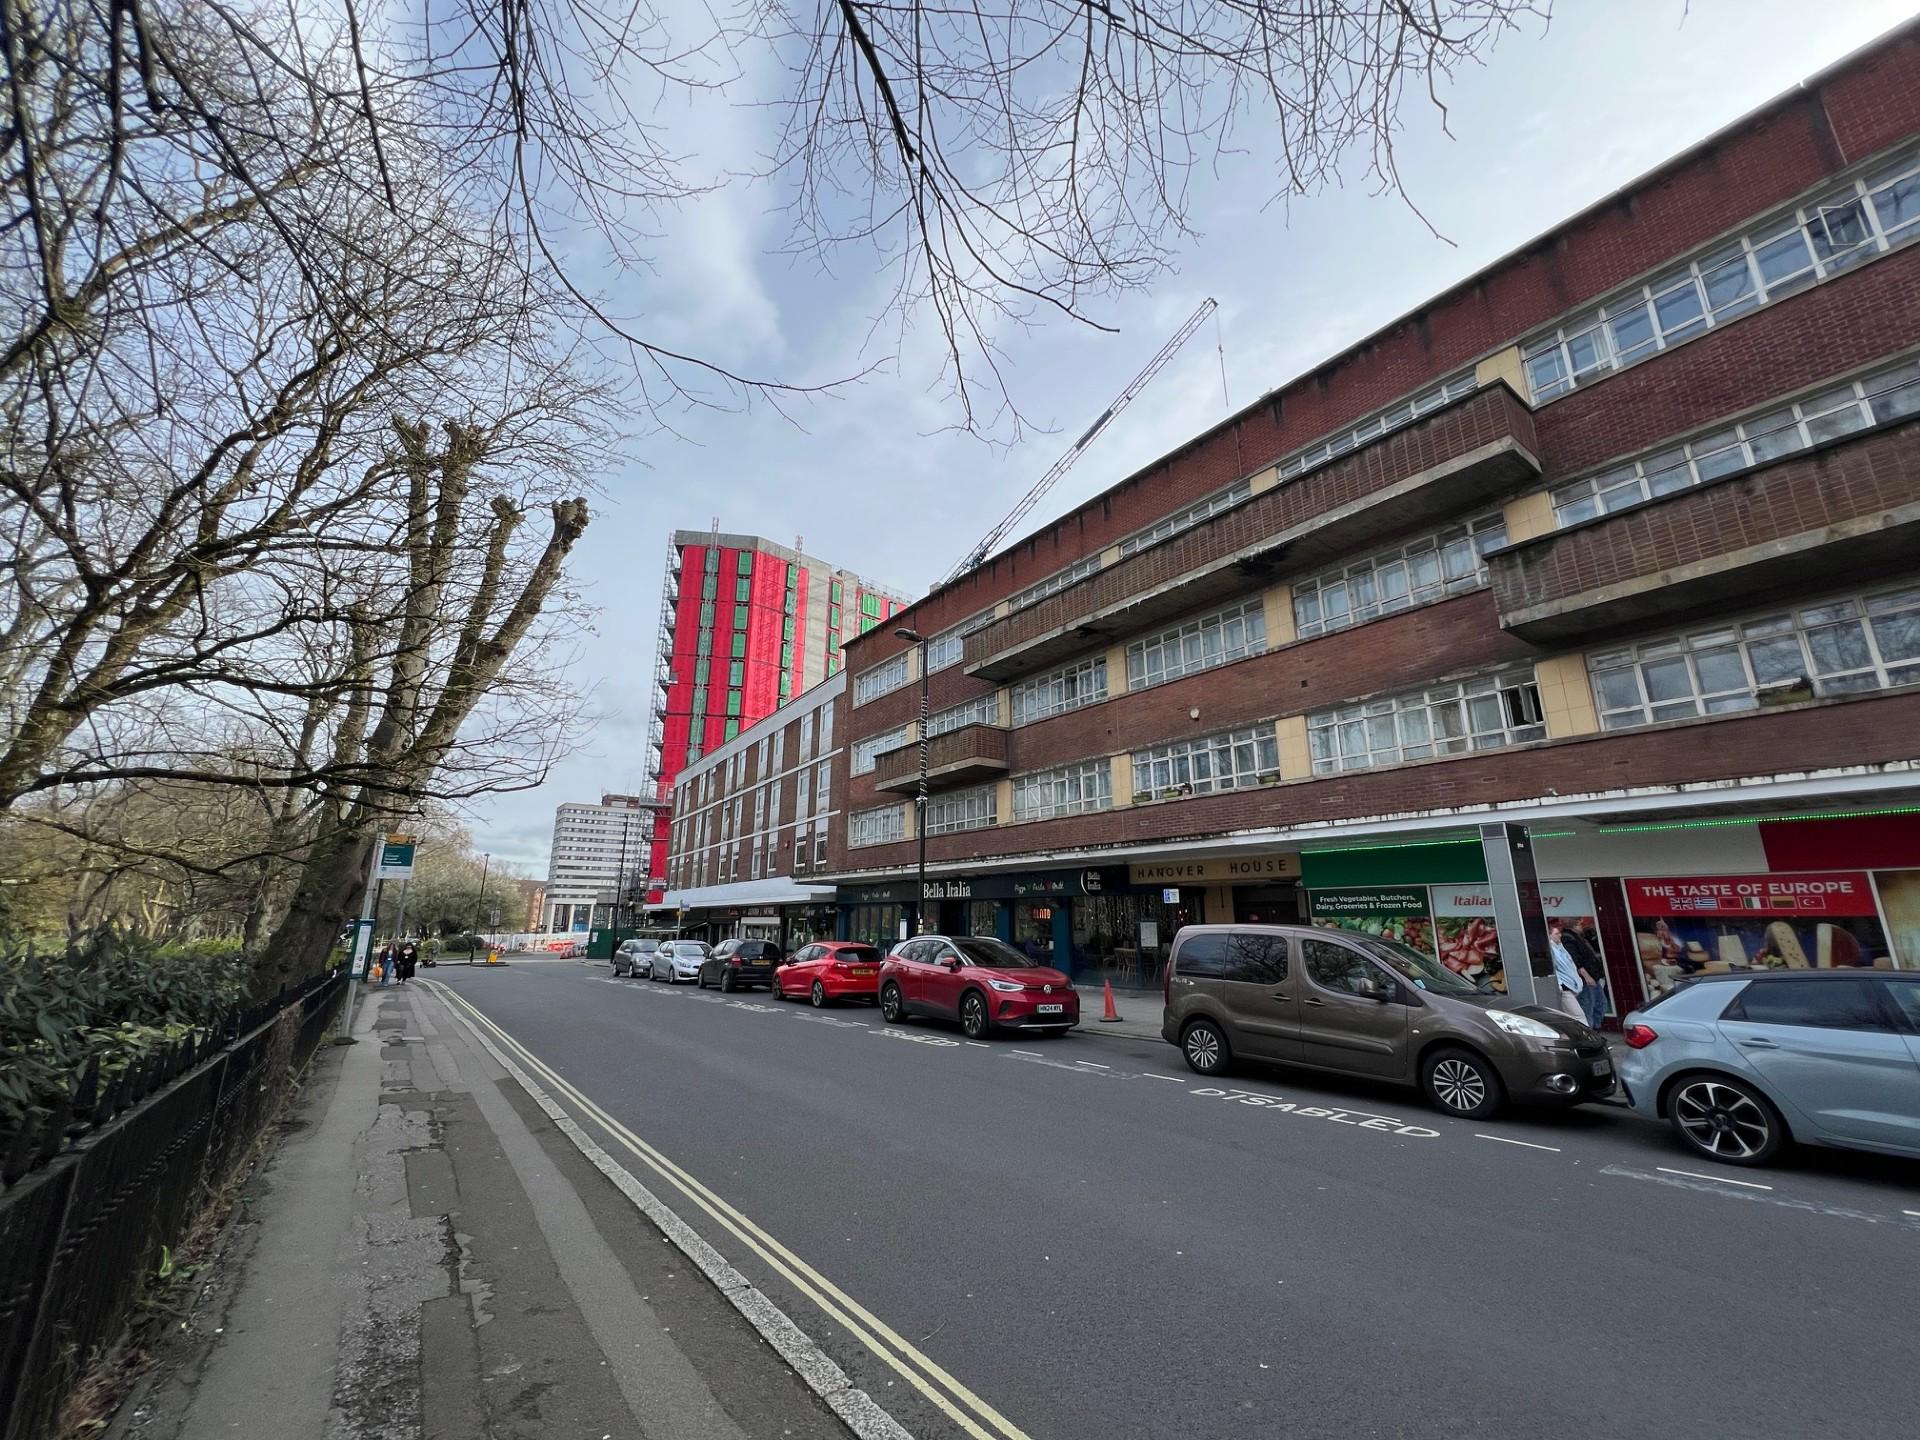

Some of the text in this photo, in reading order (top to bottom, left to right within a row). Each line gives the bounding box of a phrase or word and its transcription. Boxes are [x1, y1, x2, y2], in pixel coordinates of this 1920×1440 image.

[1137, 859, 1287, 878] HANOVER HOUSE
[923, 881, 971, 898] Bella Italia
[1642, 882, 1854, 897] THE TASTE OF EUROPE
[1189, 1087, 1440, 1138] DISABLED
